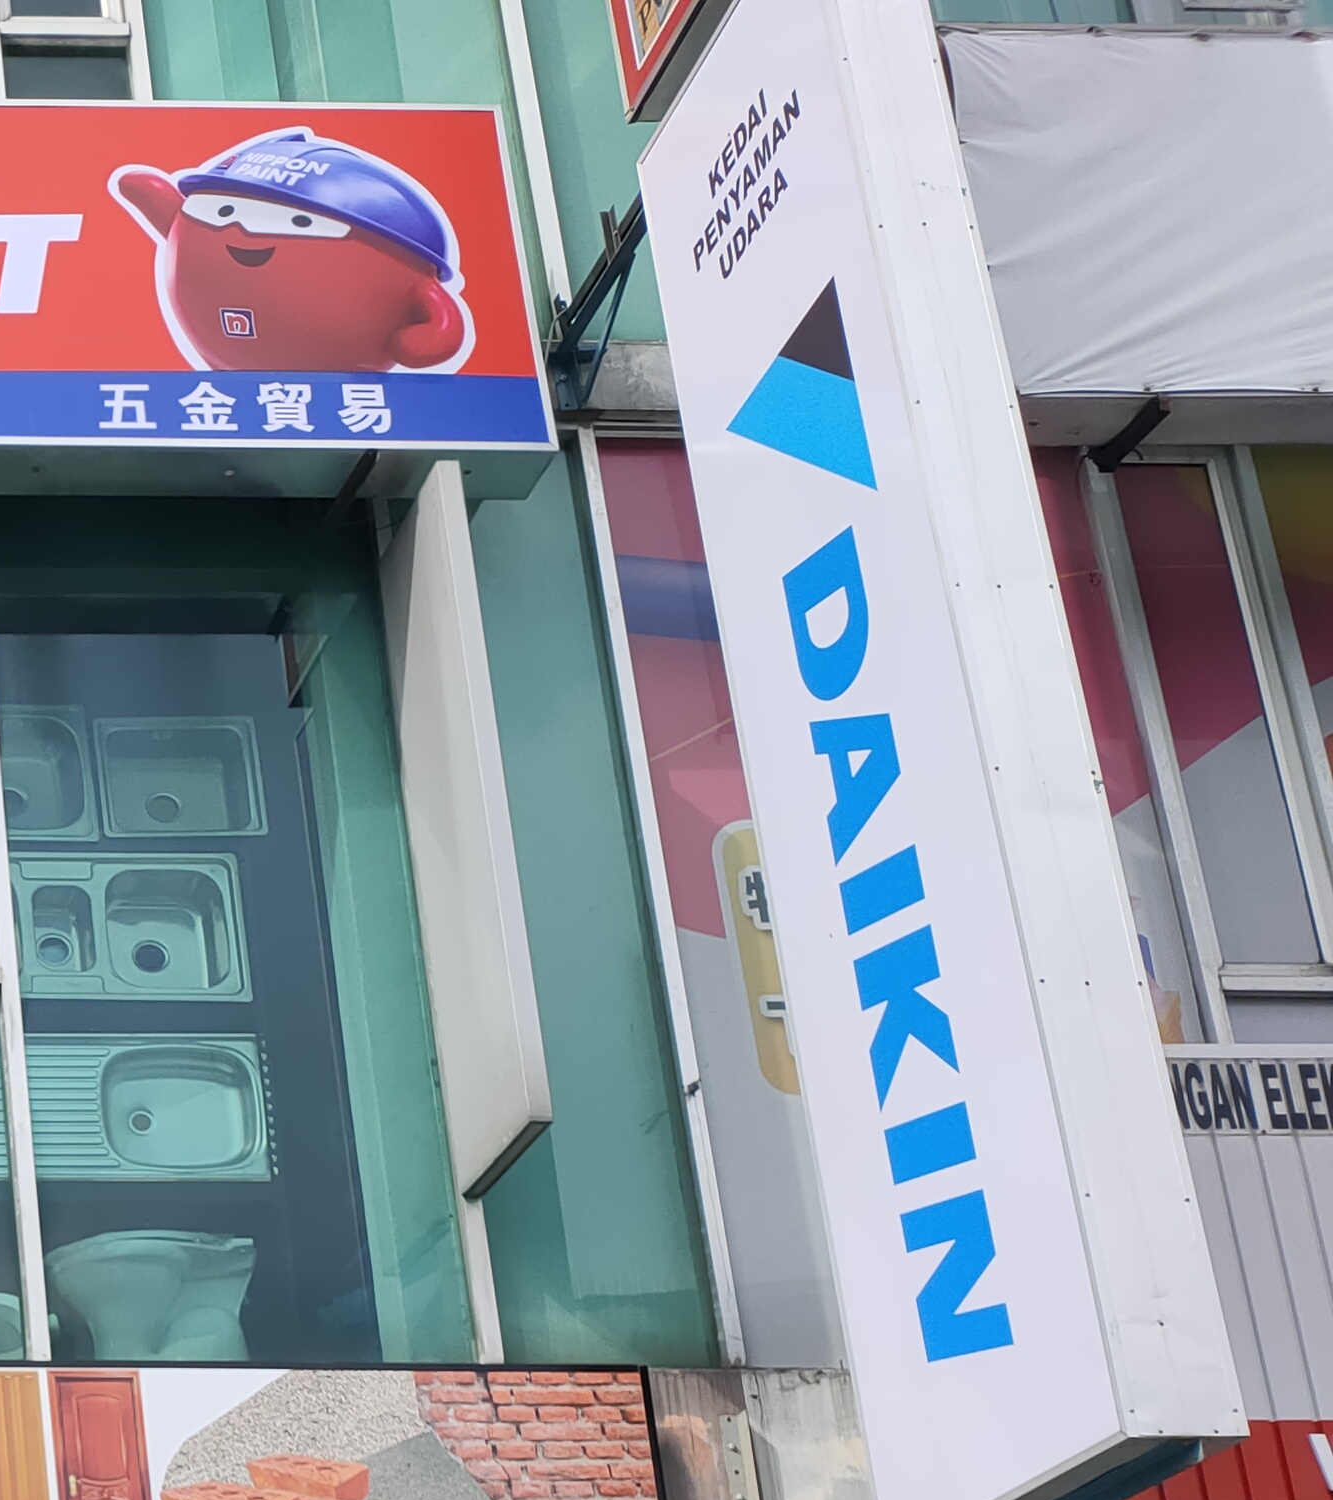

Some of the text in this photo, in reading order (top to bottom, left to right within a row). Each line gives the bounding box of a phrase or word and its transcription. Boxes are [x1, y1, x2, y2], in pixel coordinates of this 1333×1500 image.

[235, 163, 307, 187] PAINT
[242, 152, 330, 176] NIPPON
[693, 89, 802, 272] PENYAMAN
[708, 88, 769, 199] KEDAI
[719, 167, 789, 280] UDARA
[98, 381, 394, 434] 五金貿易
[781, 525, 1015, 1364] DAIKIN
